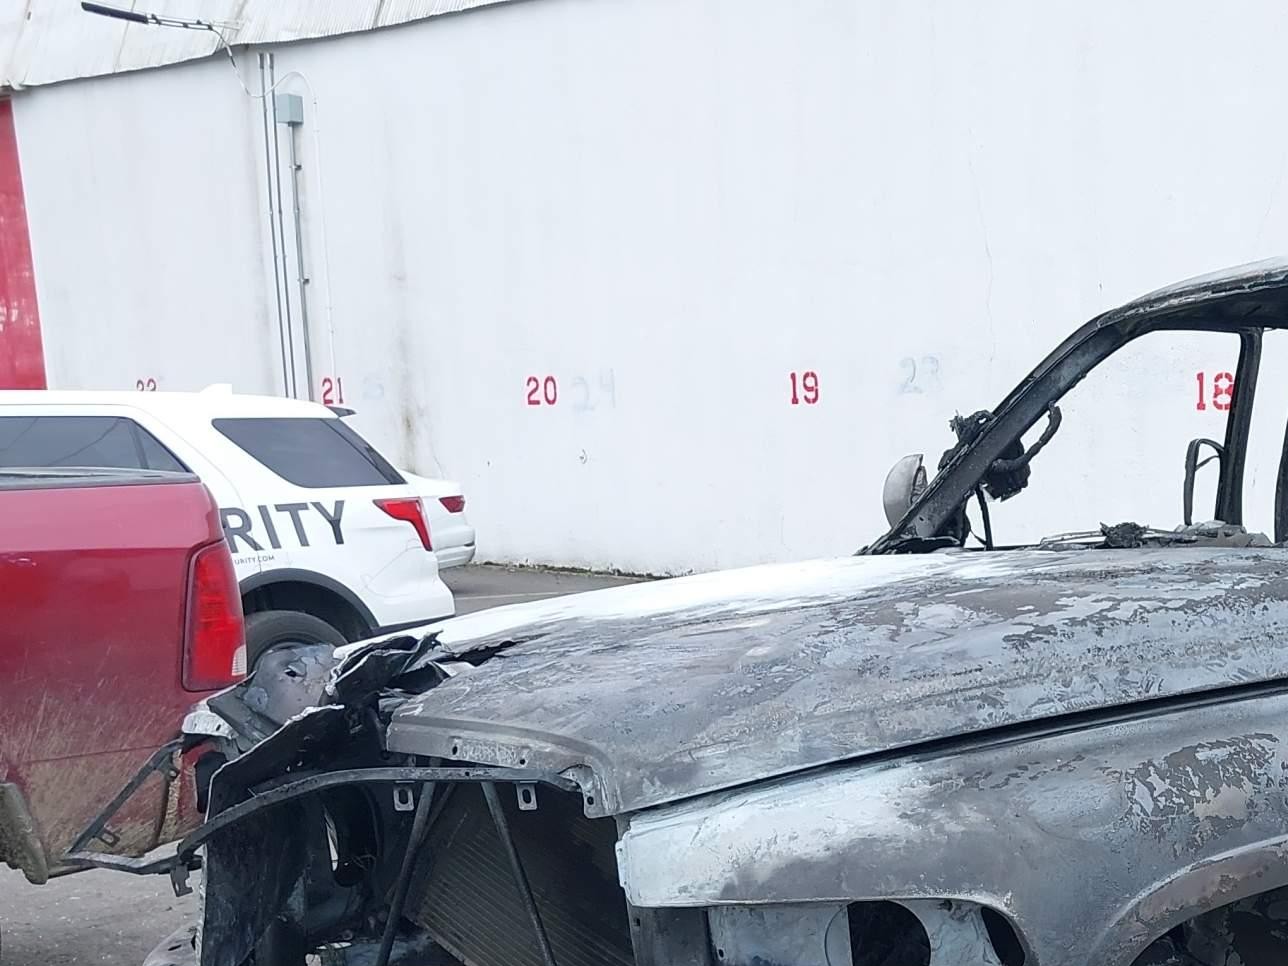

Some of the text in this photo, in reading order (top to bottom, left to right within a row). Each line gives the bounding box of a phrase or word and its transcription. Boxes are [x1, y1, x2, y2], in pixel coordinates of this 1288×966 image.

[322, 378, 344, 404] 21
[526, 376, 557, 405] 20
[790, 371, 819, 404] 19
[1196, 372, 1234, 410] 18
